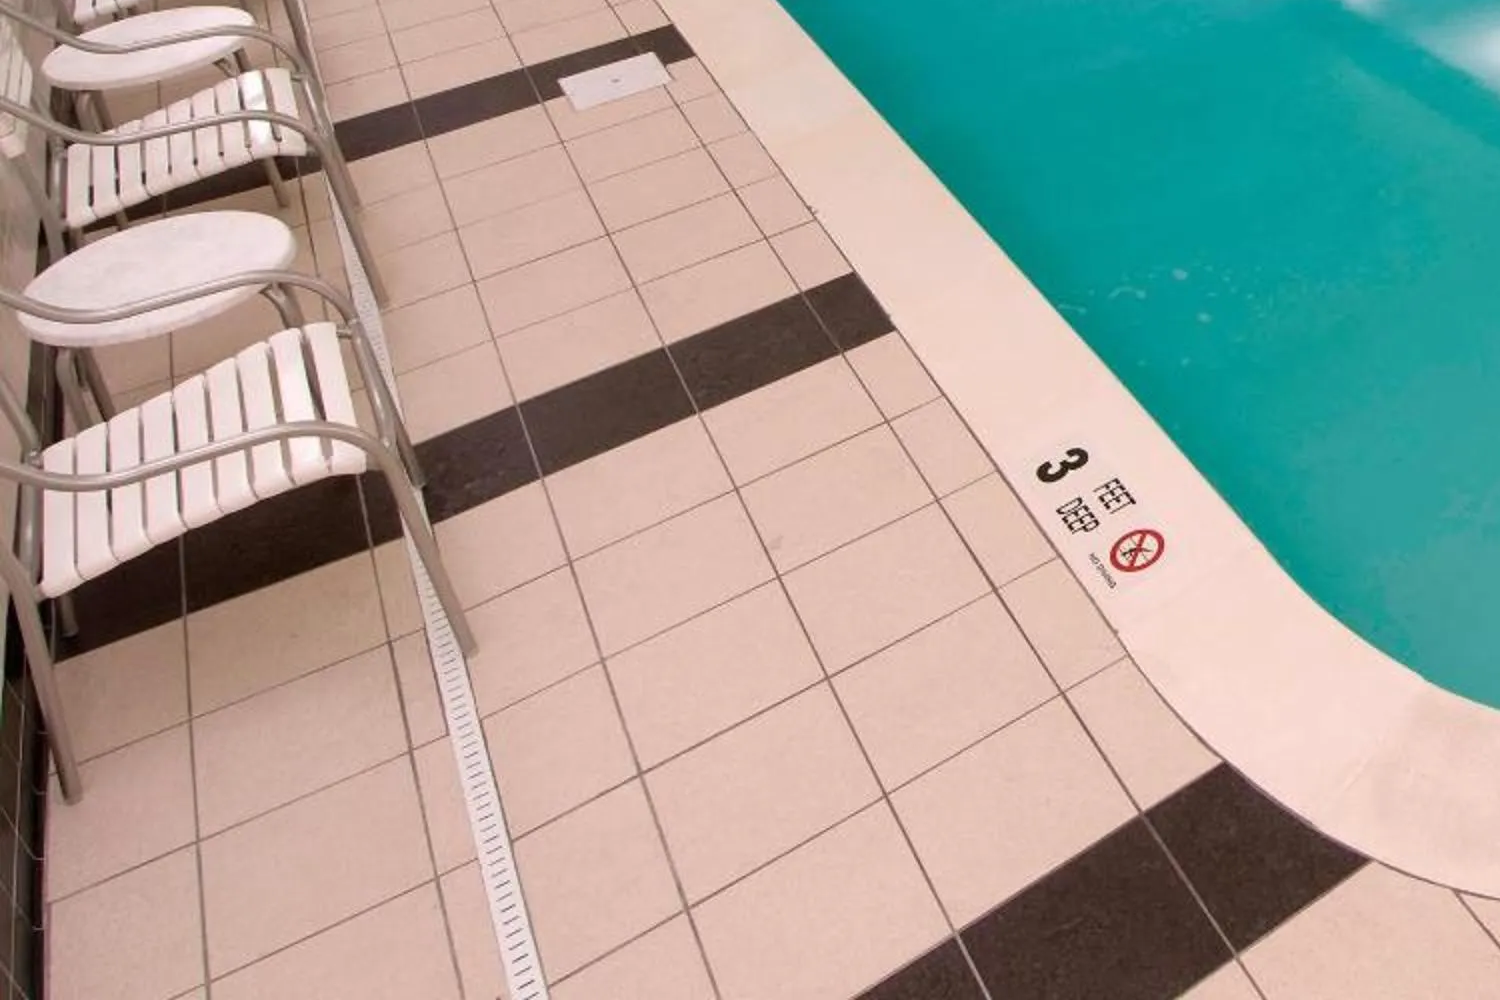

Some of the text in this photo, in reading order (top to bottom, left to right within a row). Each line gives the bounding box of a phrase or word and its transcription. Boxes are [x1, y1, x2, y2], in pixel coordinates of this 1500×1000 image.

[1036, 447, 1089, 483] 3
[1092, 477, 1136, 515] FEET
[1055, 496, 1100, 535] DEEP
